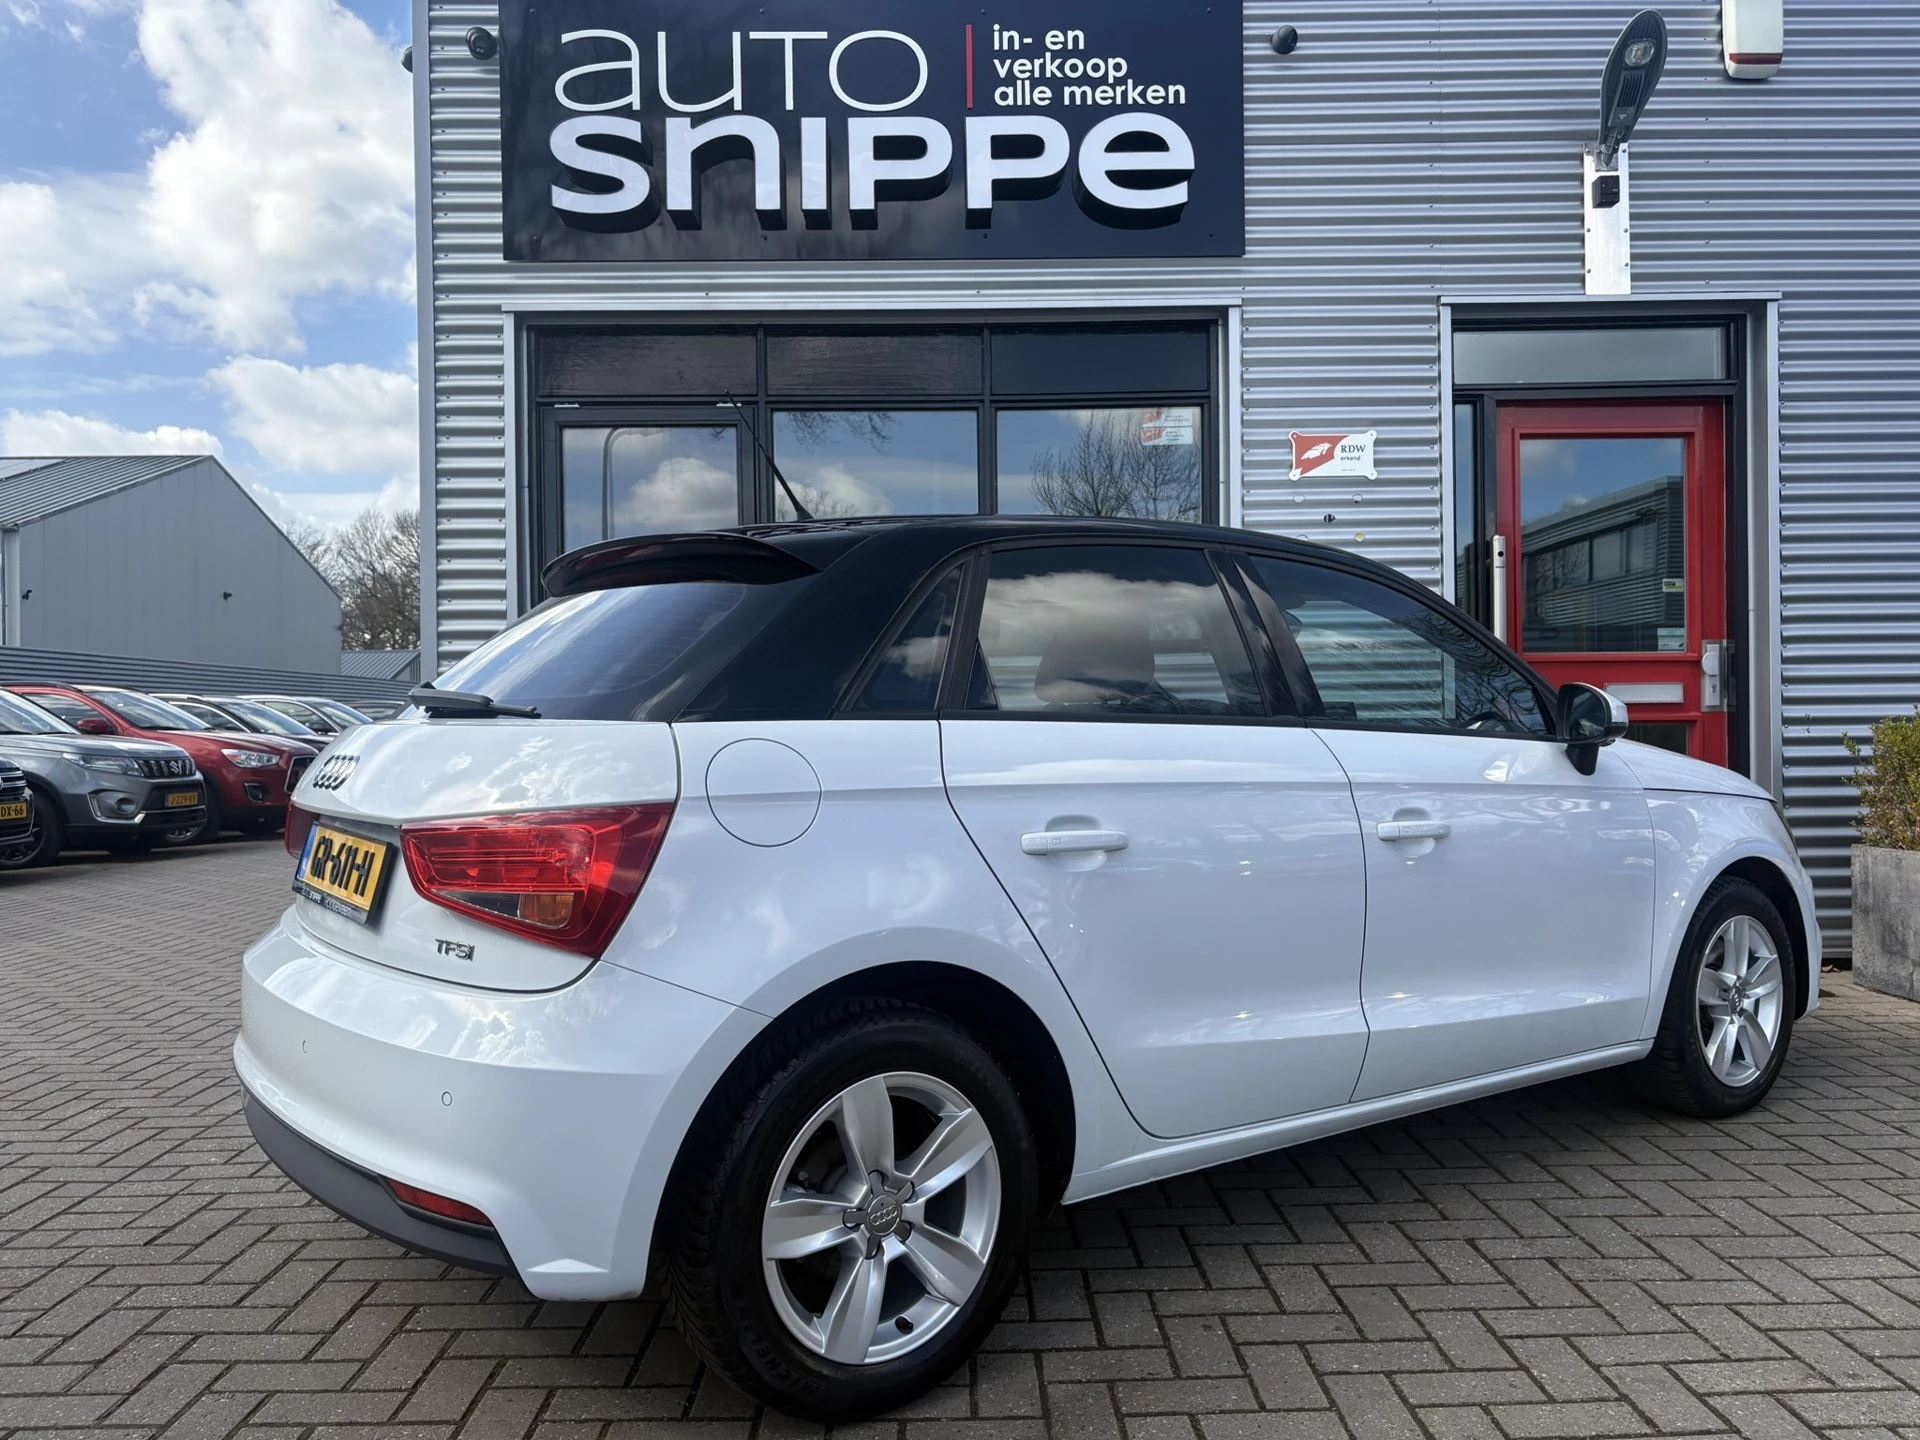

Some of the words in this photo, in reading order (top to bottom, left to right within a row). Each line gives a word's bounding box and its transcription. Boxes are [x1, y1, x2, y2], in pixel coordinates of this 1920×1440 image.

[993, 23, 1033, 50] in-
[1045, 30, 1085, 50] en
[993, 52, 1128, 83] verkoop
[994, 80, 1053, 106] alle
[1063, 79, 1186, 106] merken
[1340, 444, 1366, 454] RDW
[435, 938, 475, 961] TFSI
